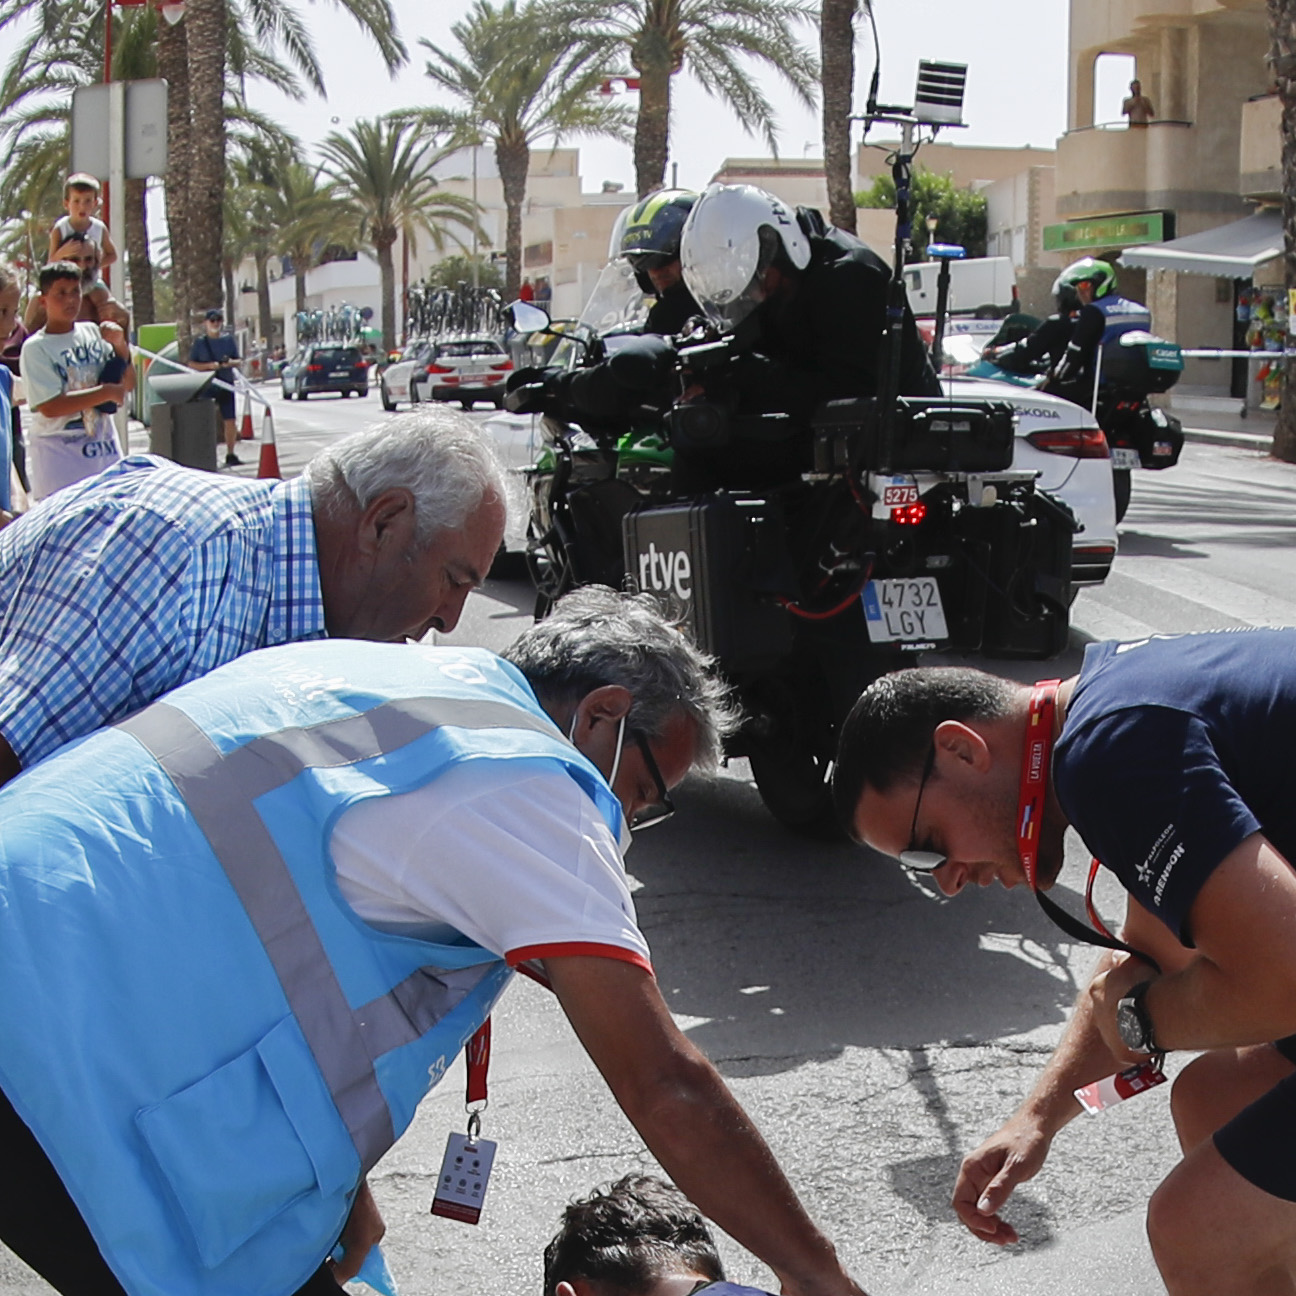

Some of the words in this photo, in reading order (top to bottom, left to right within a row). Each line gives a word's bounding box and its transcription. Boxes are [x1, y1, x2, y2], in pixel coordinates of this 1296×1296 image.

[886, 488, 918, 503] 5275
[639, 542, 691, 600] rtve
[882, 582, 939, 608] 4732
[885, 609, 926, 636] LGY
[1031, 743, 1043, 768] VUELTA
